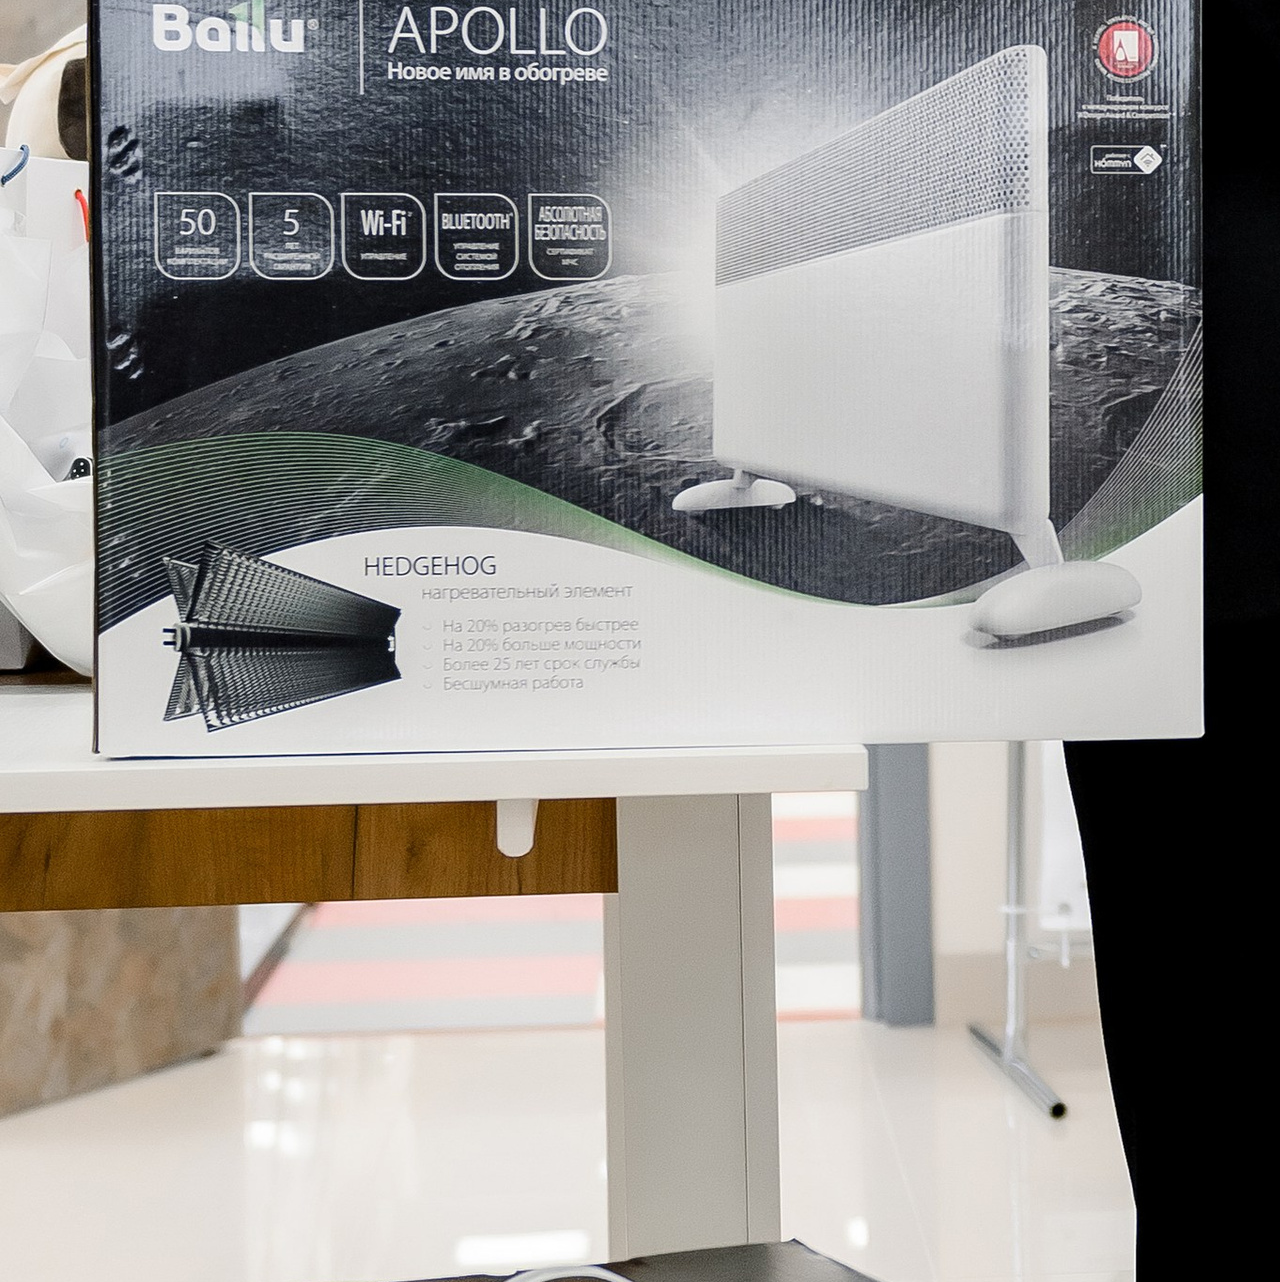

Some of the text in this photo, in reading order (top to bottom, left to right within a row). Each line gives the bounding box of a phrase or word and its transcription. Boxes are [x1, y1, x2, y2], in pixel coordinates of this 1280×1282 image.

[387, 6, 608, 56] APOLLO
[387, 62, 608, 85] Новое имя в обогреве
[180, 208, 216, 235] 50
[283, 208, 300, 235] 5
[360, 210, 407, 236] Wi-Fi
[441, 213, 511, 230] BLUETOOTH
[538, 206, 602, 222] АБСОЛЮТНАЯ
[534, 224, 607, 241] БЕЗОПАСНОСТЬ
[364, 555, 497, 577] HEDGEHOG
[422, 583, 633, 602] нагревательный элемент
[443, 619, 640, 635] На 20% разогрев быстрее
[443, 637, 641, 653] На 20% больше мощности
[443, 655, 640, 673] Более 25 лет срок службы
[443, 675, 584, 692] Бесшумная работа
